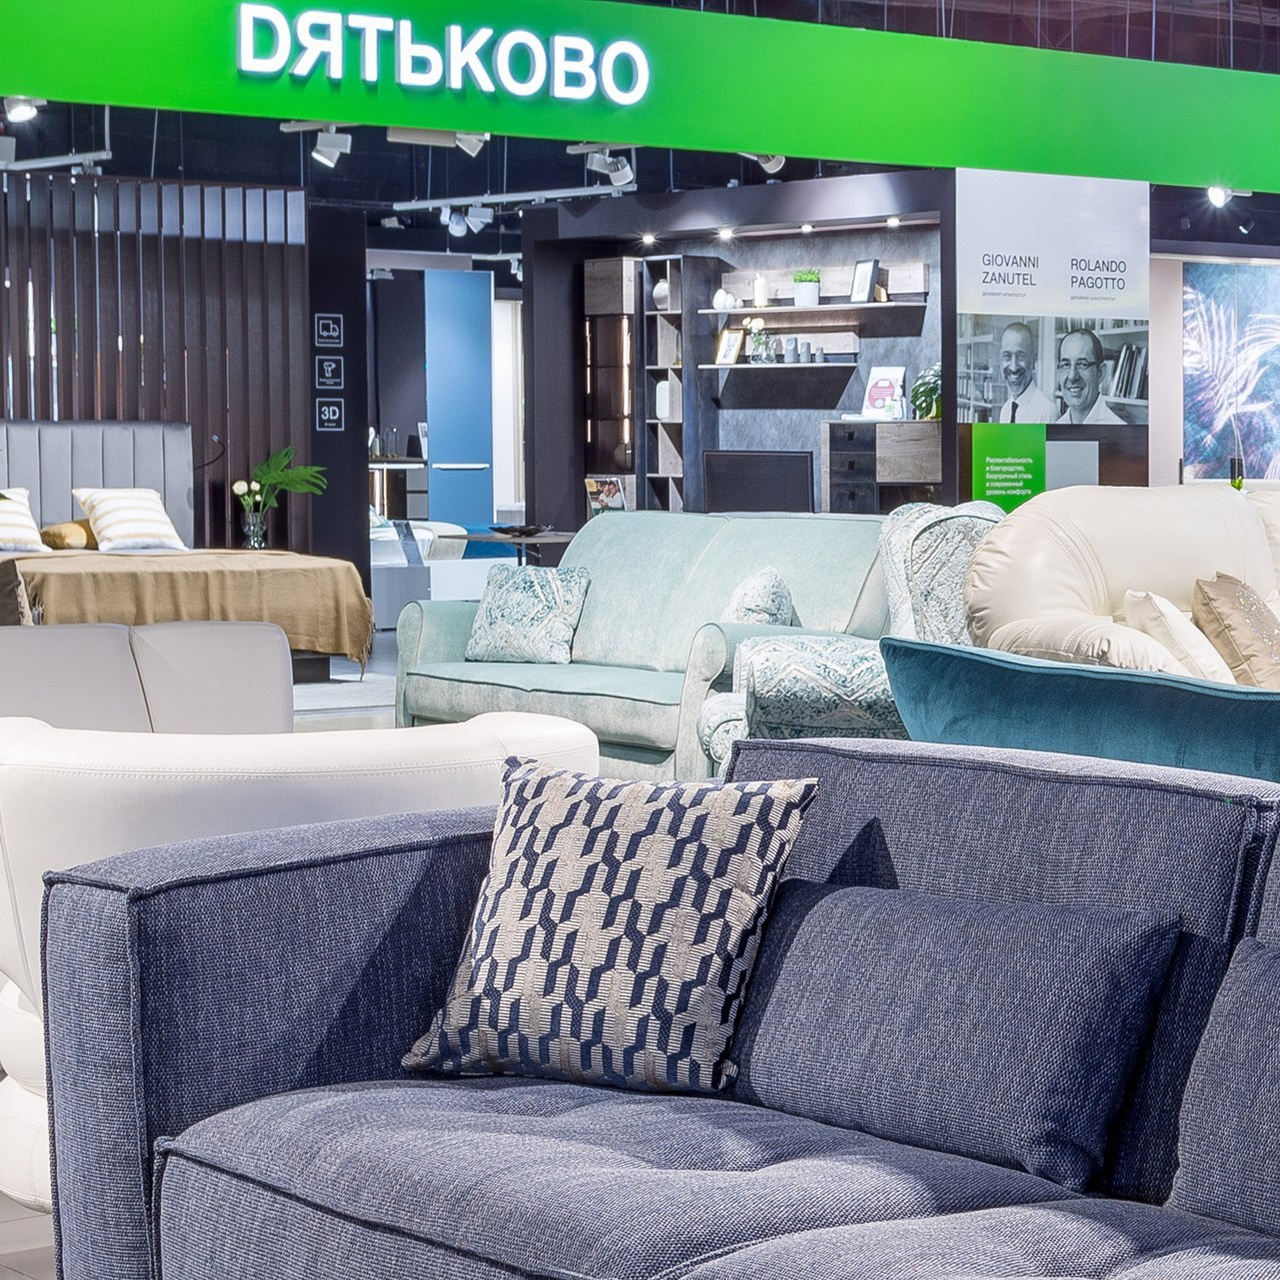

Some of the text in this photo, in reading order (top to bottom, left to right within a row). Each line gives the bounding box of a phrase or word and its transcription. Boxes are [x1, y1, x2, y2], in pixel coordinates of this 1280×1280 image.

[982, 253, 1039, 269] GIOVANNI
[1071, 258, 1127, 273] ROLANDO
[982, 271, 1036, 286] ZANUTEL
[1071, 276, 1125, 290] PAGOTTO
[321, 406, 340, 420] 3D
